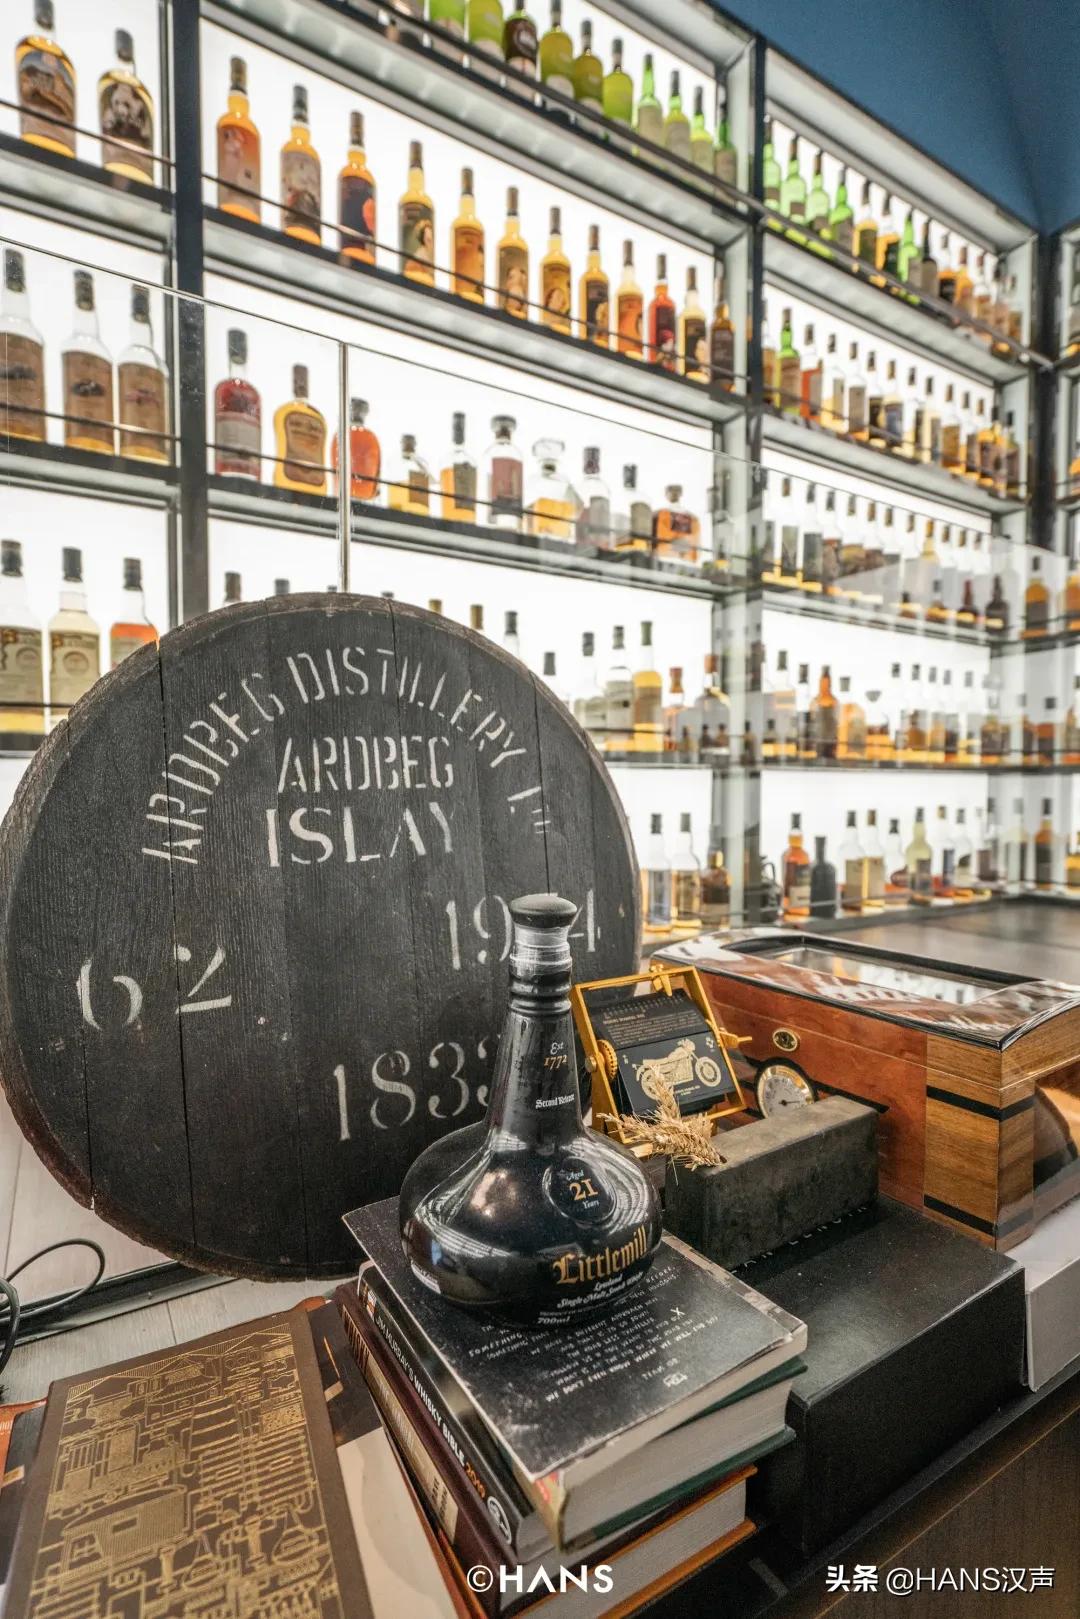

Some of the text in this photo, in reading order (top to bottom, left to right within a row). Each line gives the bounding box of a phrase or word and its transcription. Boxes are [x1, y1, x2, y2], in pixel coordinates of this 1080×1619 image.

[142, 672, 286, 864] ARDBEG
[286, 647, 527, 768] DISTILLERY
[278, 735, 454, 793] ARDBEG
[266, 802, 454, 868] ISLAY
[446, 888, 601, 970] 194
[544, 1054, 568, 1070] 1772
[550, 1041, 564, 1055] Est
[536, 1094, 575, 1109] Second Release
[569, 1178, 599, 1201] 21
[552, 1223, 648, 1286] Littlemill
[537, 1315, 570, 1325] 700ml
[414, 1374, 442, 1427] WHISKY
[442, 1422, 465, 1467] BIBLE
